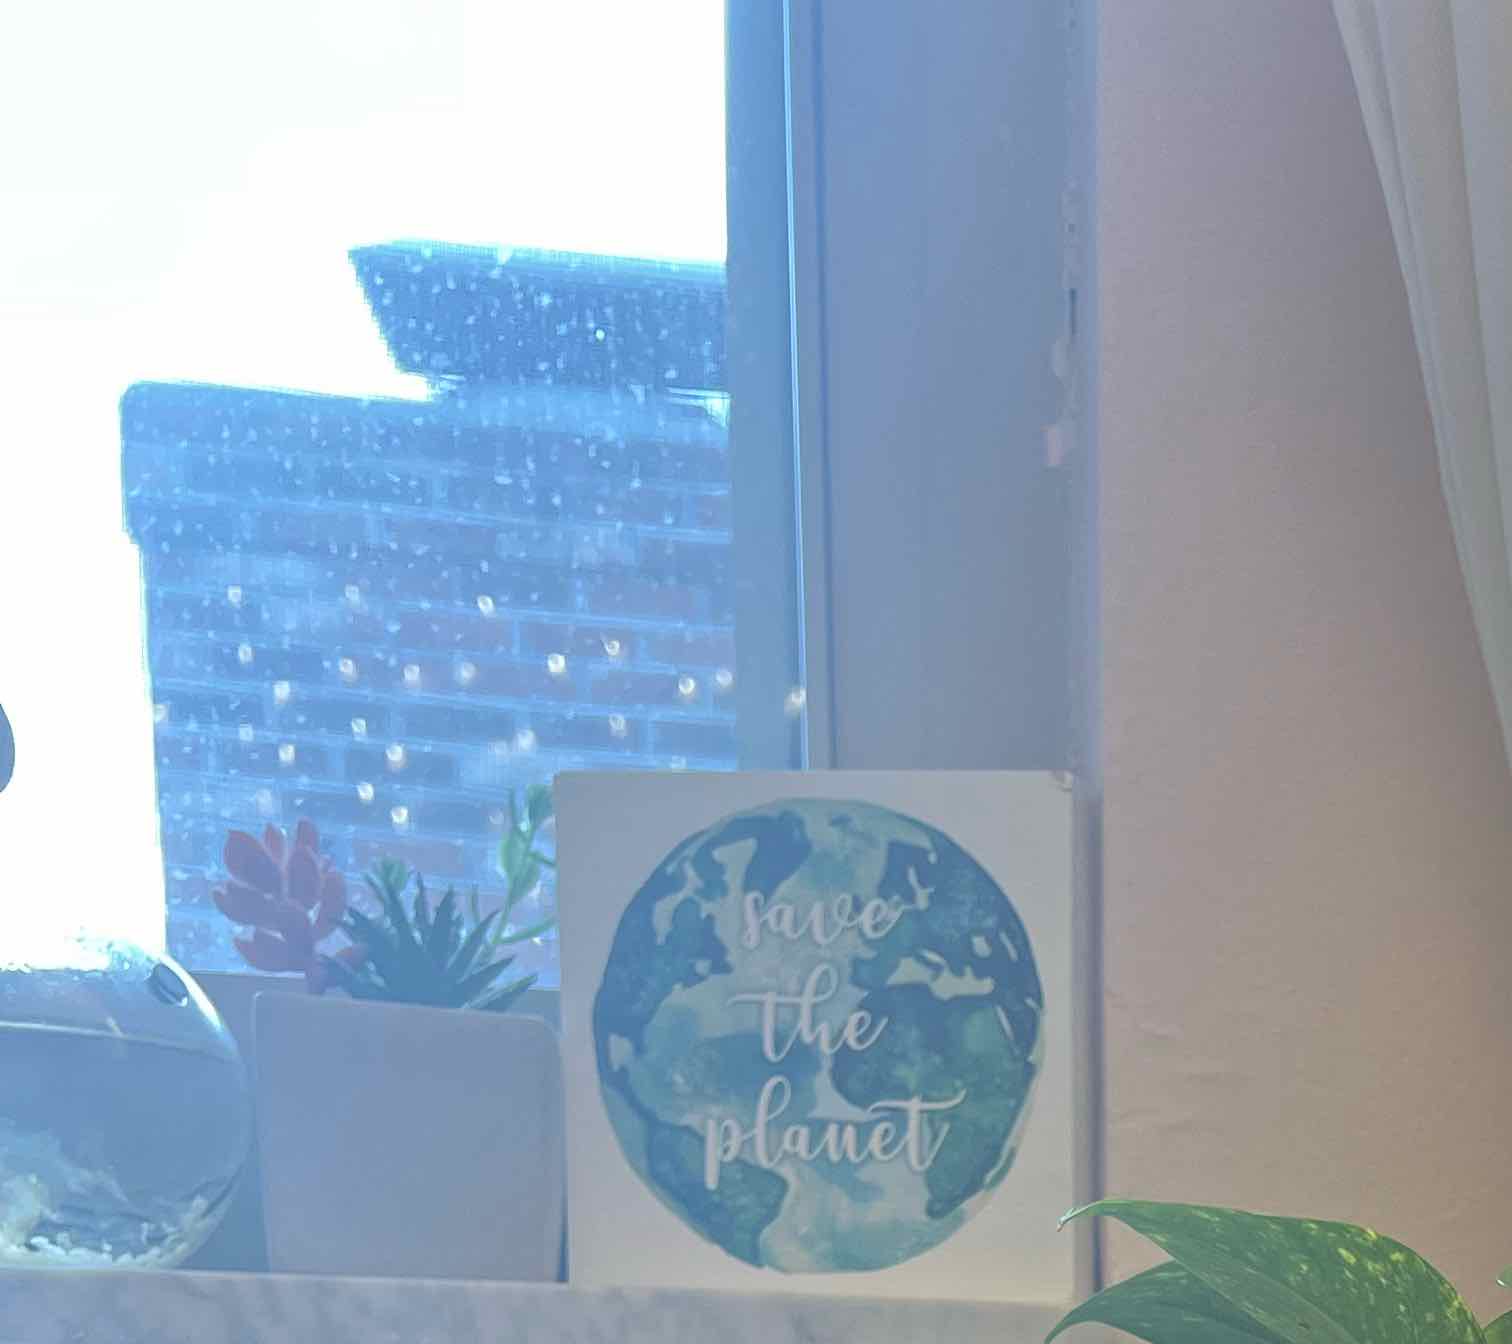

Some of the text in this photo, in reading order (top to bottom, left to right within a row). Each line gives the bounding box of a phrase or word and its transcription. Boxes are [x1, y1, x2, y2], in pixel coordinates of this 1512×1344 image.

[739, 888, 907, 947] save
[727, 964, 888, 1063] the
[705, 1075, 968, 1191] planet
